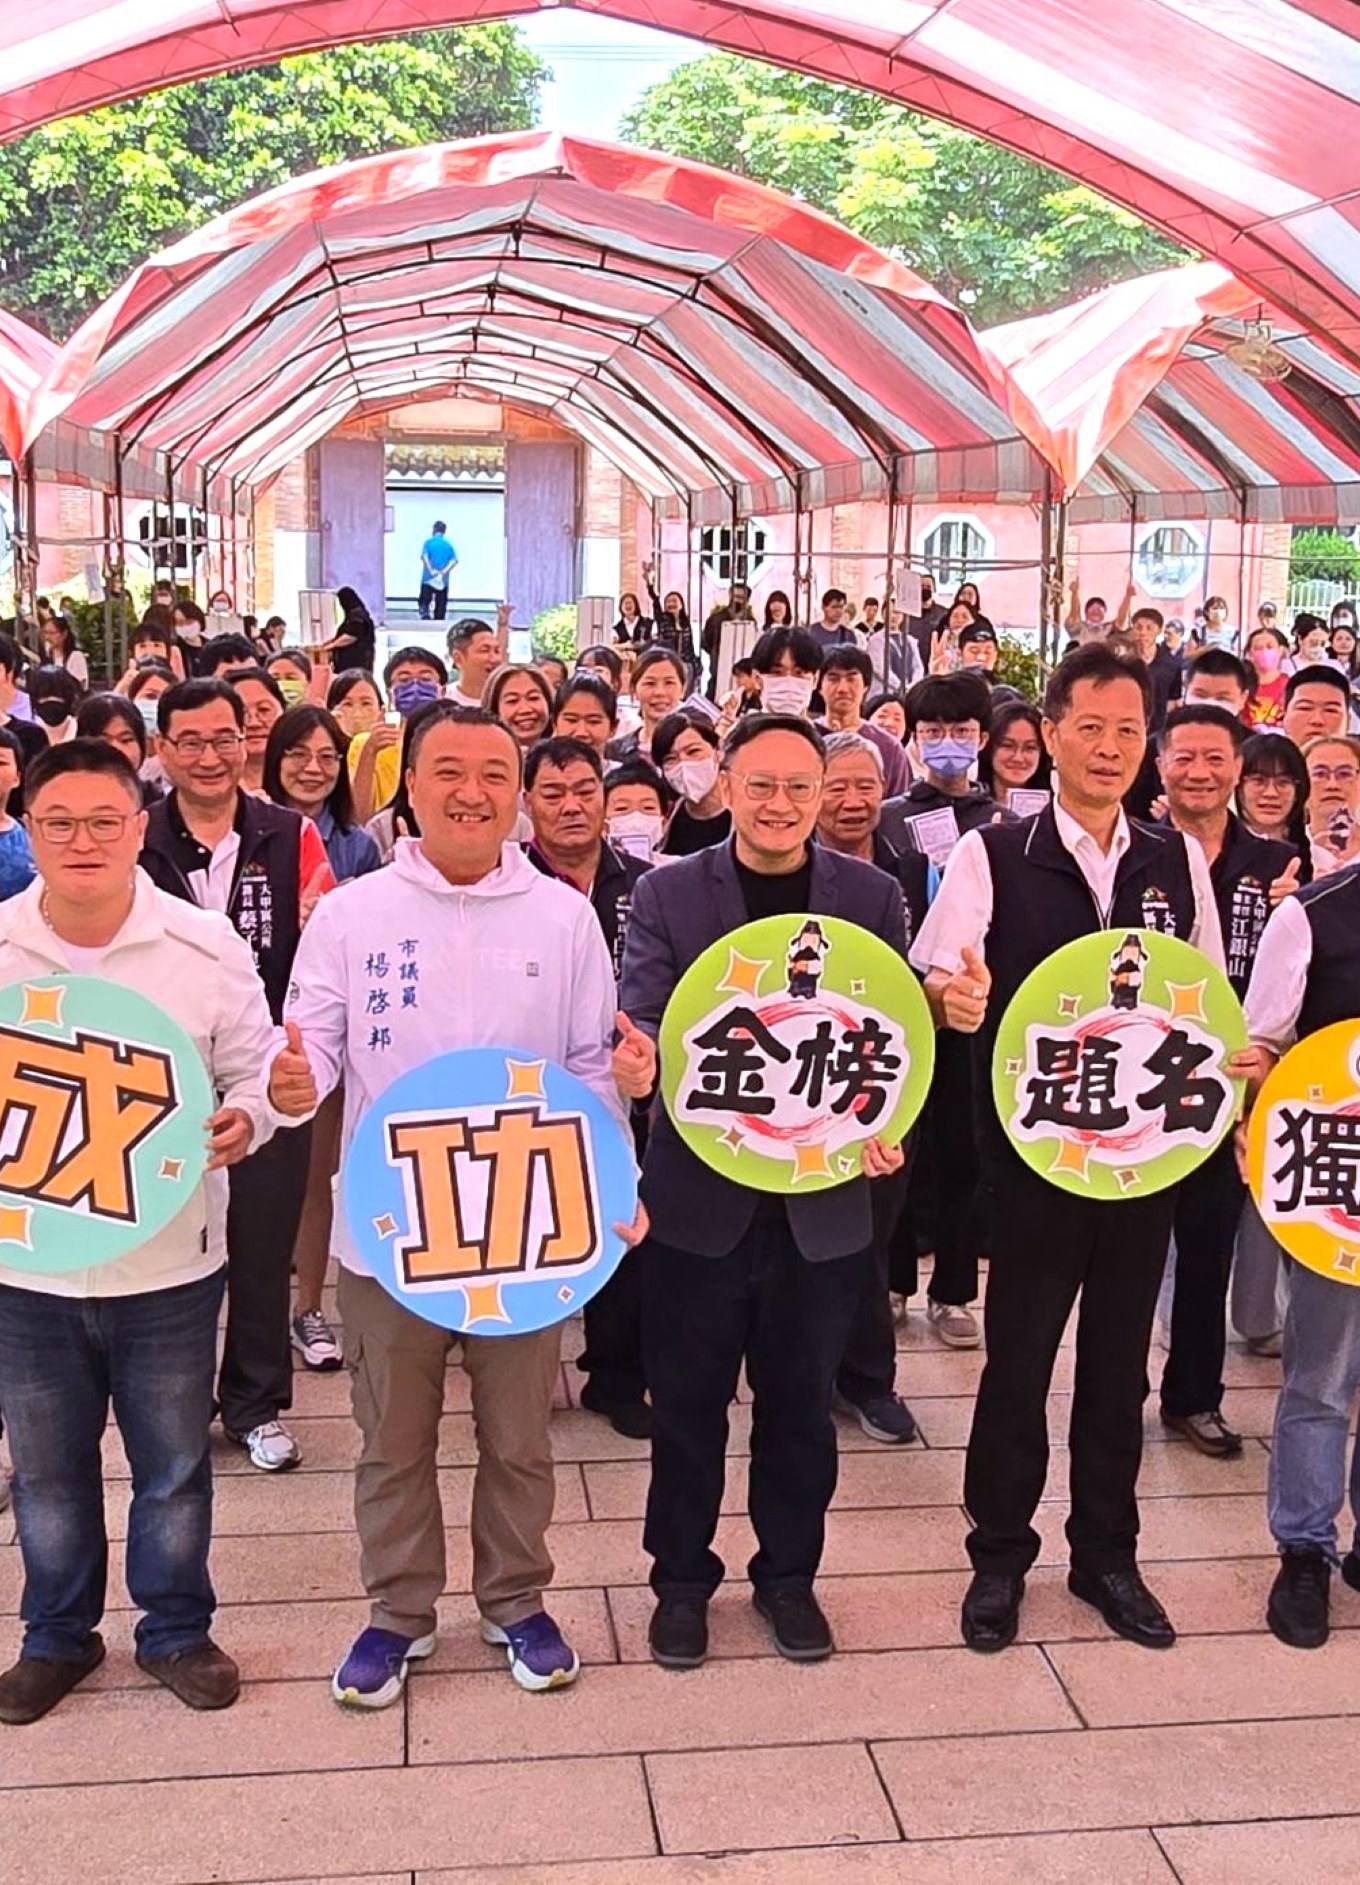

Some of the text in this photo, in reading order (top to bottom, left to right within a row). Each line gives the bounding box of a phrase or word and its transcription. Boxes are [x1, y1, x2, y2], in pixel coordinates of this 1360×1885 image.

[397, 938, 421, 1010] 市議員
[686, 1006, 901, 1125] 金榜
[1020, 1029, 1226, 1133] 題名
[388, 1106, 597, 1284] 功
